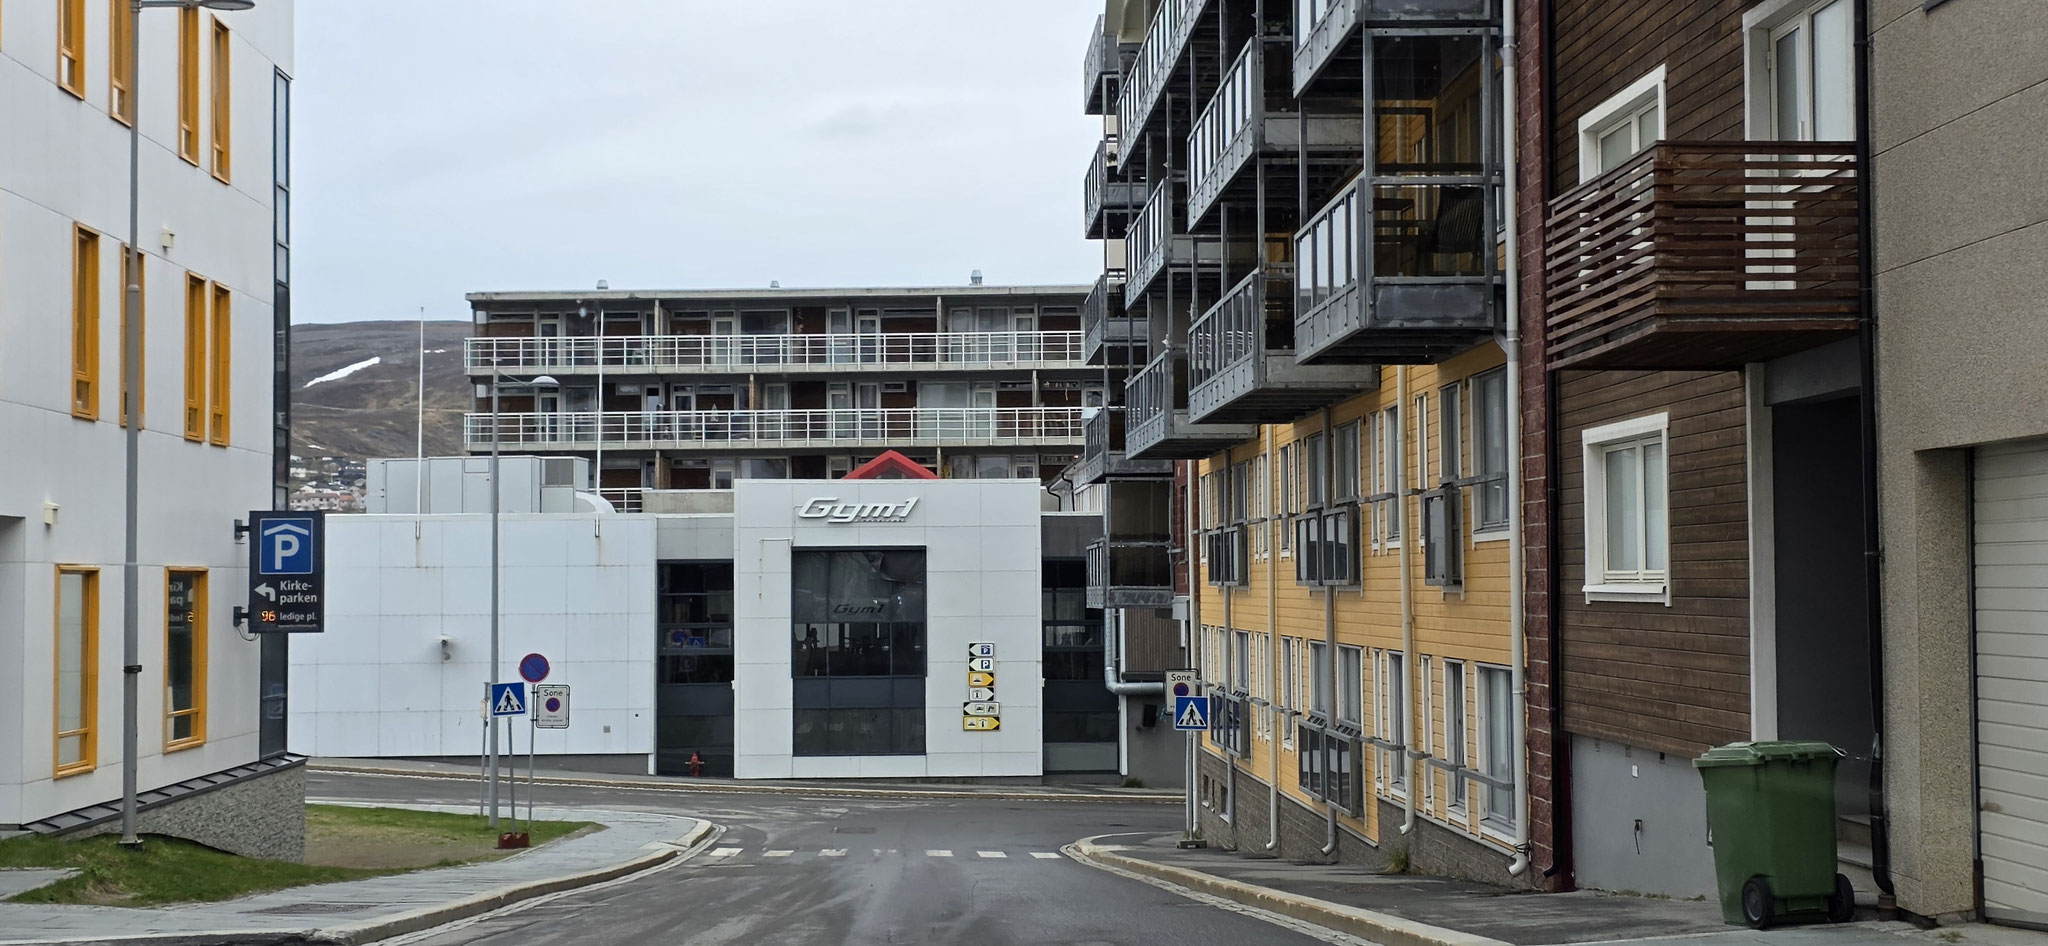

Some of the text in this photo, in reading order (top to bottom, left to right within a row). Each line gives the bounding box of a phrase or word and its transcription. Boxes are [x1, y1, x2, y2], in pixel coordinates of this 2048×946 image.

[798, 496, 919, 523] Gym1
[274, 534, 300, 570] P
[279, 580, 312, 591] Kirke-
[279, 592, 318, 606] parken
[261, 610, 276, 622] 96
[279, 612, 318, 623] ledige pl.
[982, 660, 989, 669] P
[1171, 673, 1191, 681] Sone
